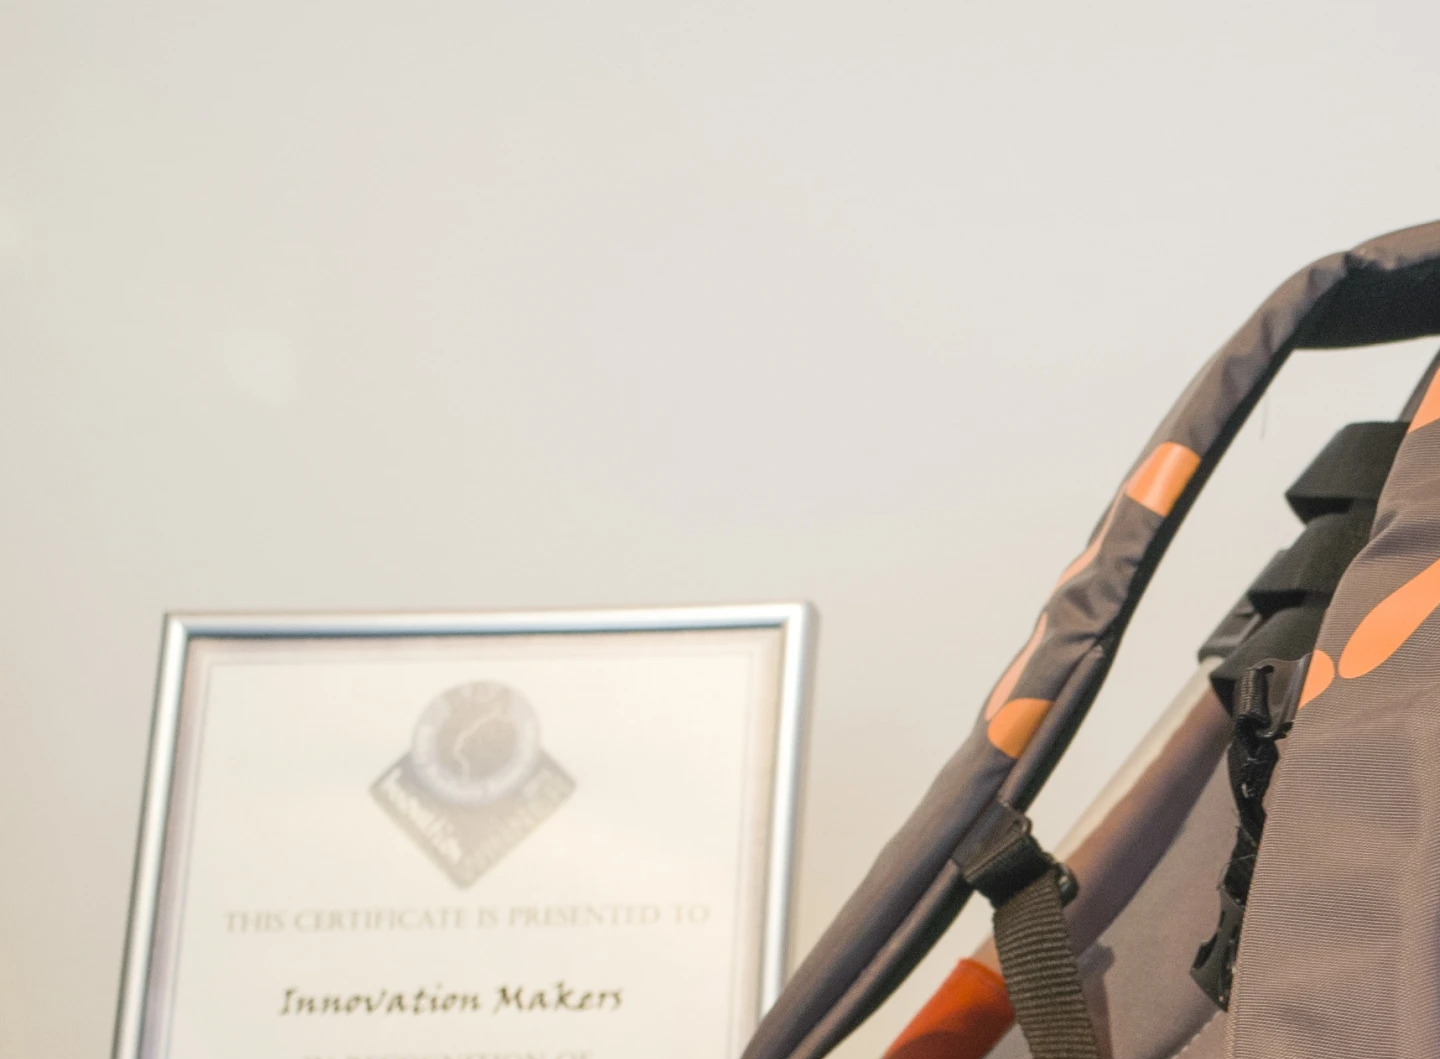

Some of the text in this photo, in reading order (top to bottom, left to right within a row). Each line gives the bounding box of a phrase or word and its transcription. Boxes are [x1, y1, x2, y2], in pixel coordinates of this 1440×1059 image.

[224, 902, 712, 935] THIS CERTIFICATE IS PRESENTED TO
[278, 980, 624, 1016] Innovation Makers
